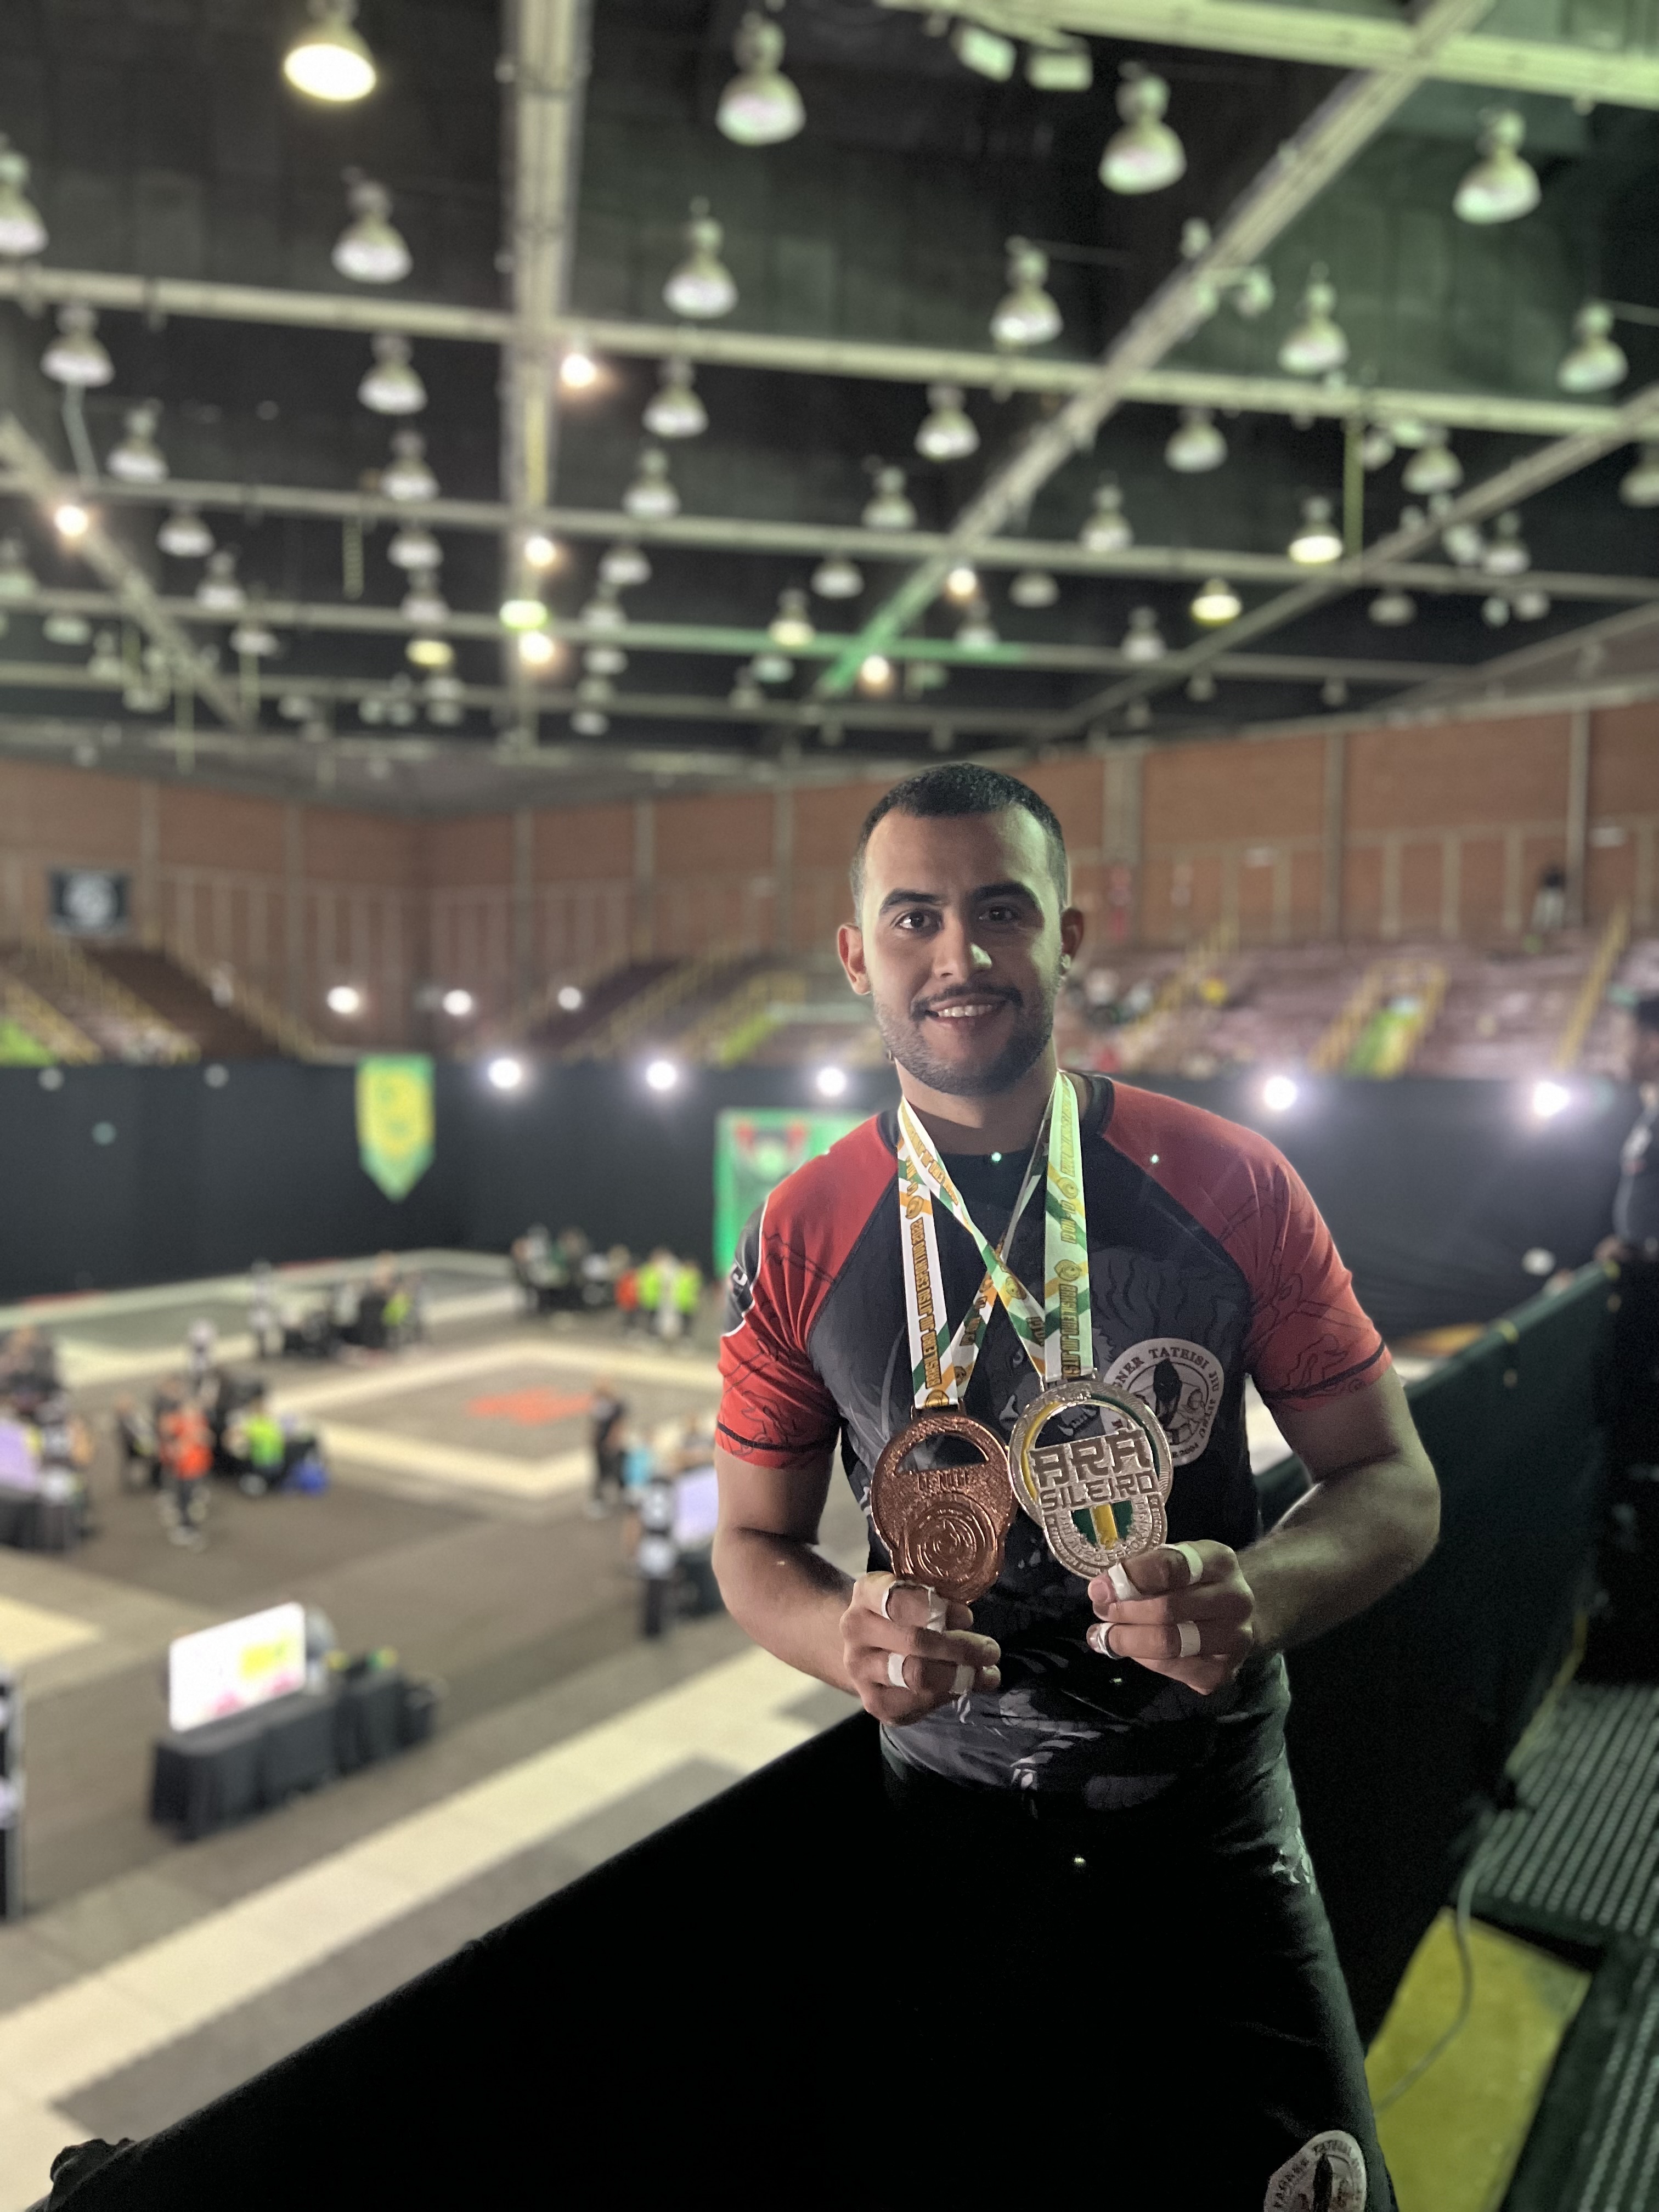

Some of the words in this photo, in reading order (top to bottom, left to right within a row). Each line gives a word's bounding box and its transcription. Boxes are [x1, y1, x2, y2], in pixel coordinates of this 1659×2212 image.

[910, 1217, 925, 1245] 2022
[912, 1240, 931, 1293] ESPORTIVO
[1059, 1284, 1079, 1336] BRASILEIRO
[921, 1330, 942, 1389] BRASILEIRO
[1148, 1347, 1210, 1369] TATEISI
[1209, 1370, 1220, 1392] JIU
[1042, 1470, 1158, 1513] SILEIRO
